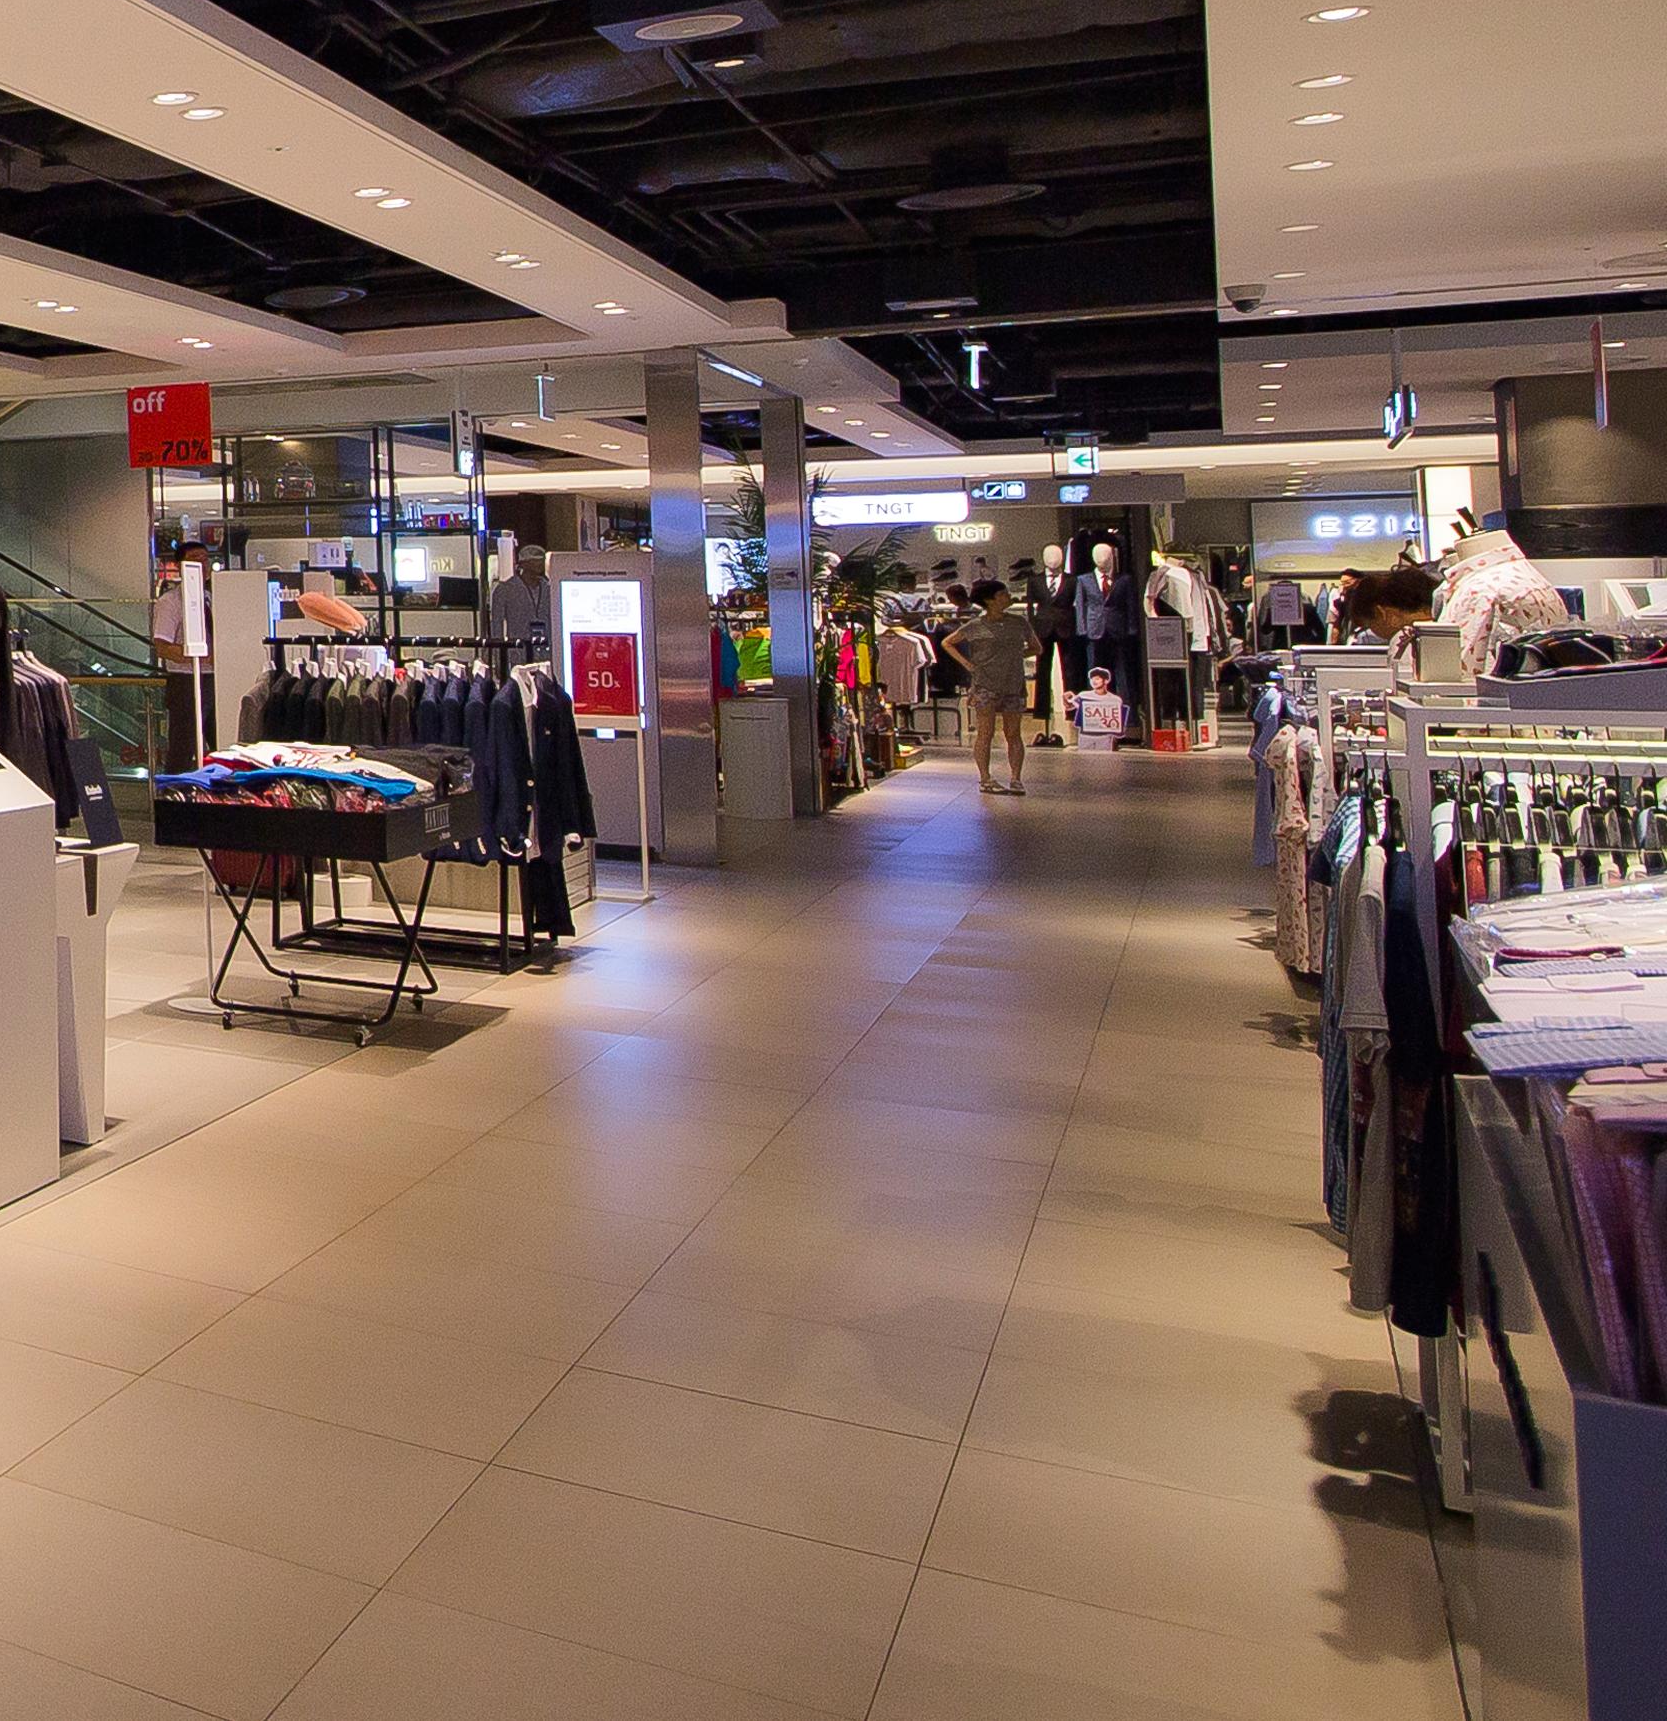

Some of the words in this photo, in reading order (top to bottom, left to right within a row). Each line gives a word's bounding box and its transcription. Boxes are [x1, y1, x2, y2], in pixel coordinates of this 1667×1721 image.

[132, 391, 167, 414] off
[864, 502, 915, 515] TNGT
[938, 527, 990, 539] TNGT
[1085, 707, 1119, 719] SALE
